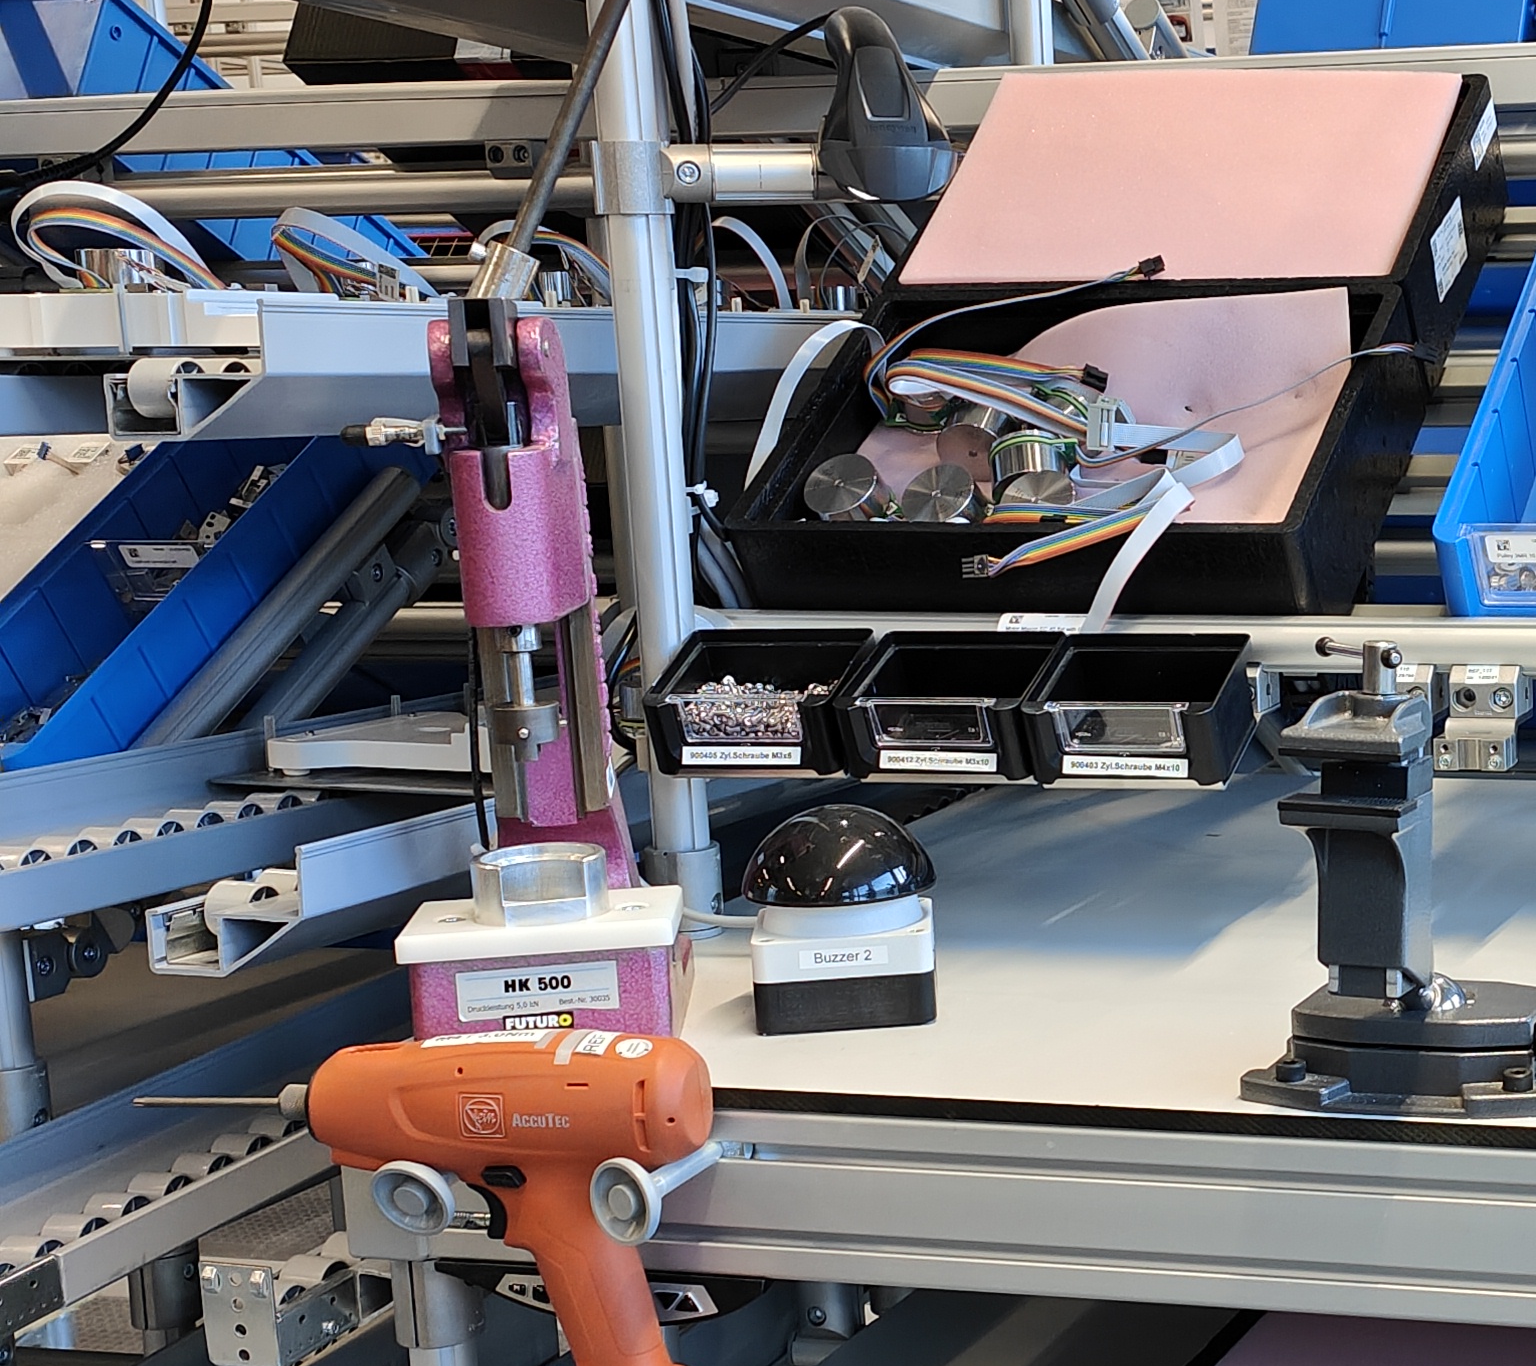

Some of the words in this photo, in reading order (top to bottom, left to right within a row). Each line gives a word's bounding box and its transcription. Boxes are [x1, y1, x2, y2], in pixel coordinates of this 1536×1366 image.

[1155, 763, 1180, 772] M4x10
[813, 949, 860, 964] Buzzer
[864, 949, 872, 962] 2
[504, 979, 531, 993] HK
[538, 975, 571, 990] 500
[505, 1013, 573, 1029] FUTURO
